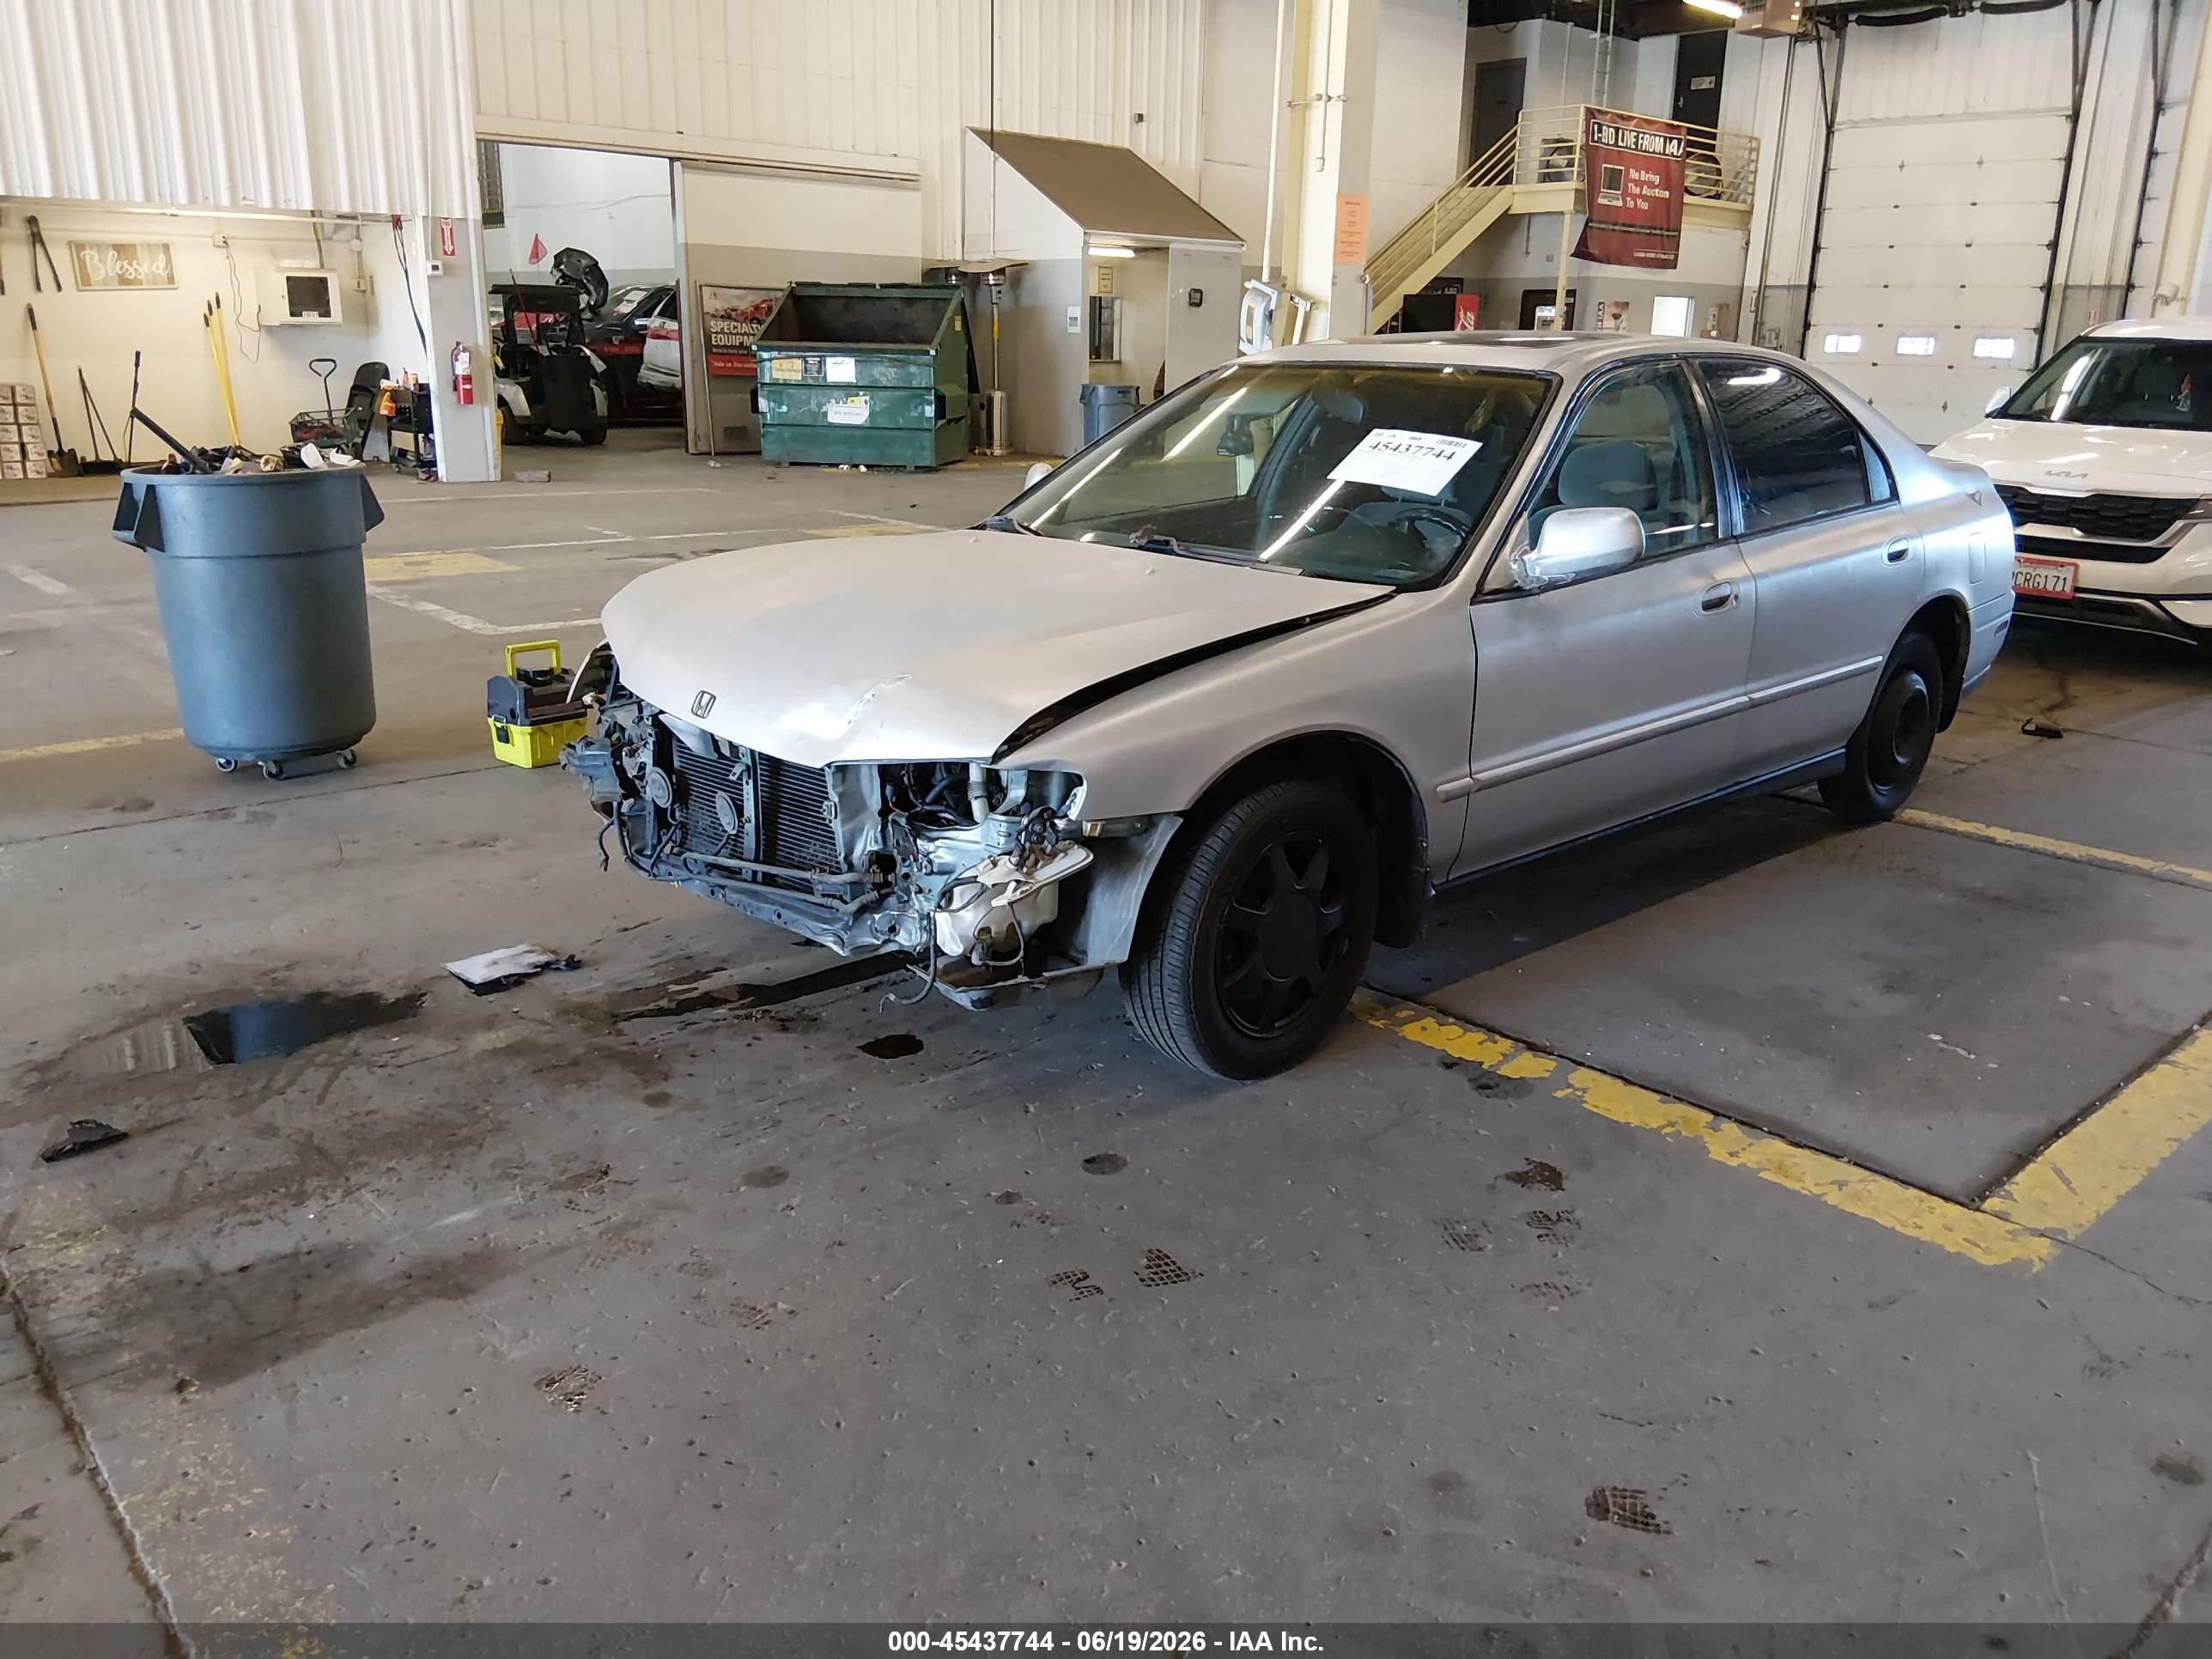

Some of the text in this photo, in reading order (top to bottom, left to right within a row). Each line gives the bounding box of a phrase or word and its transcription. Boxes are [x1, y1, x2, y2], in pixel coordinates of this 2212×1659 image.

[1618, 129, 1637, 149] LIVE
[1638, 133, 1664, 154] FROM
[1640, 170, 1660, 185] Bring
[1627, 182, 1669, 199] The Auction
[1626, 197, 1649, 210] To You
[80, 250, 170, 281] Blessed
[711, 333, 754, 347] EQUIPM
[1369, 441, 1457, 461] 45437744
